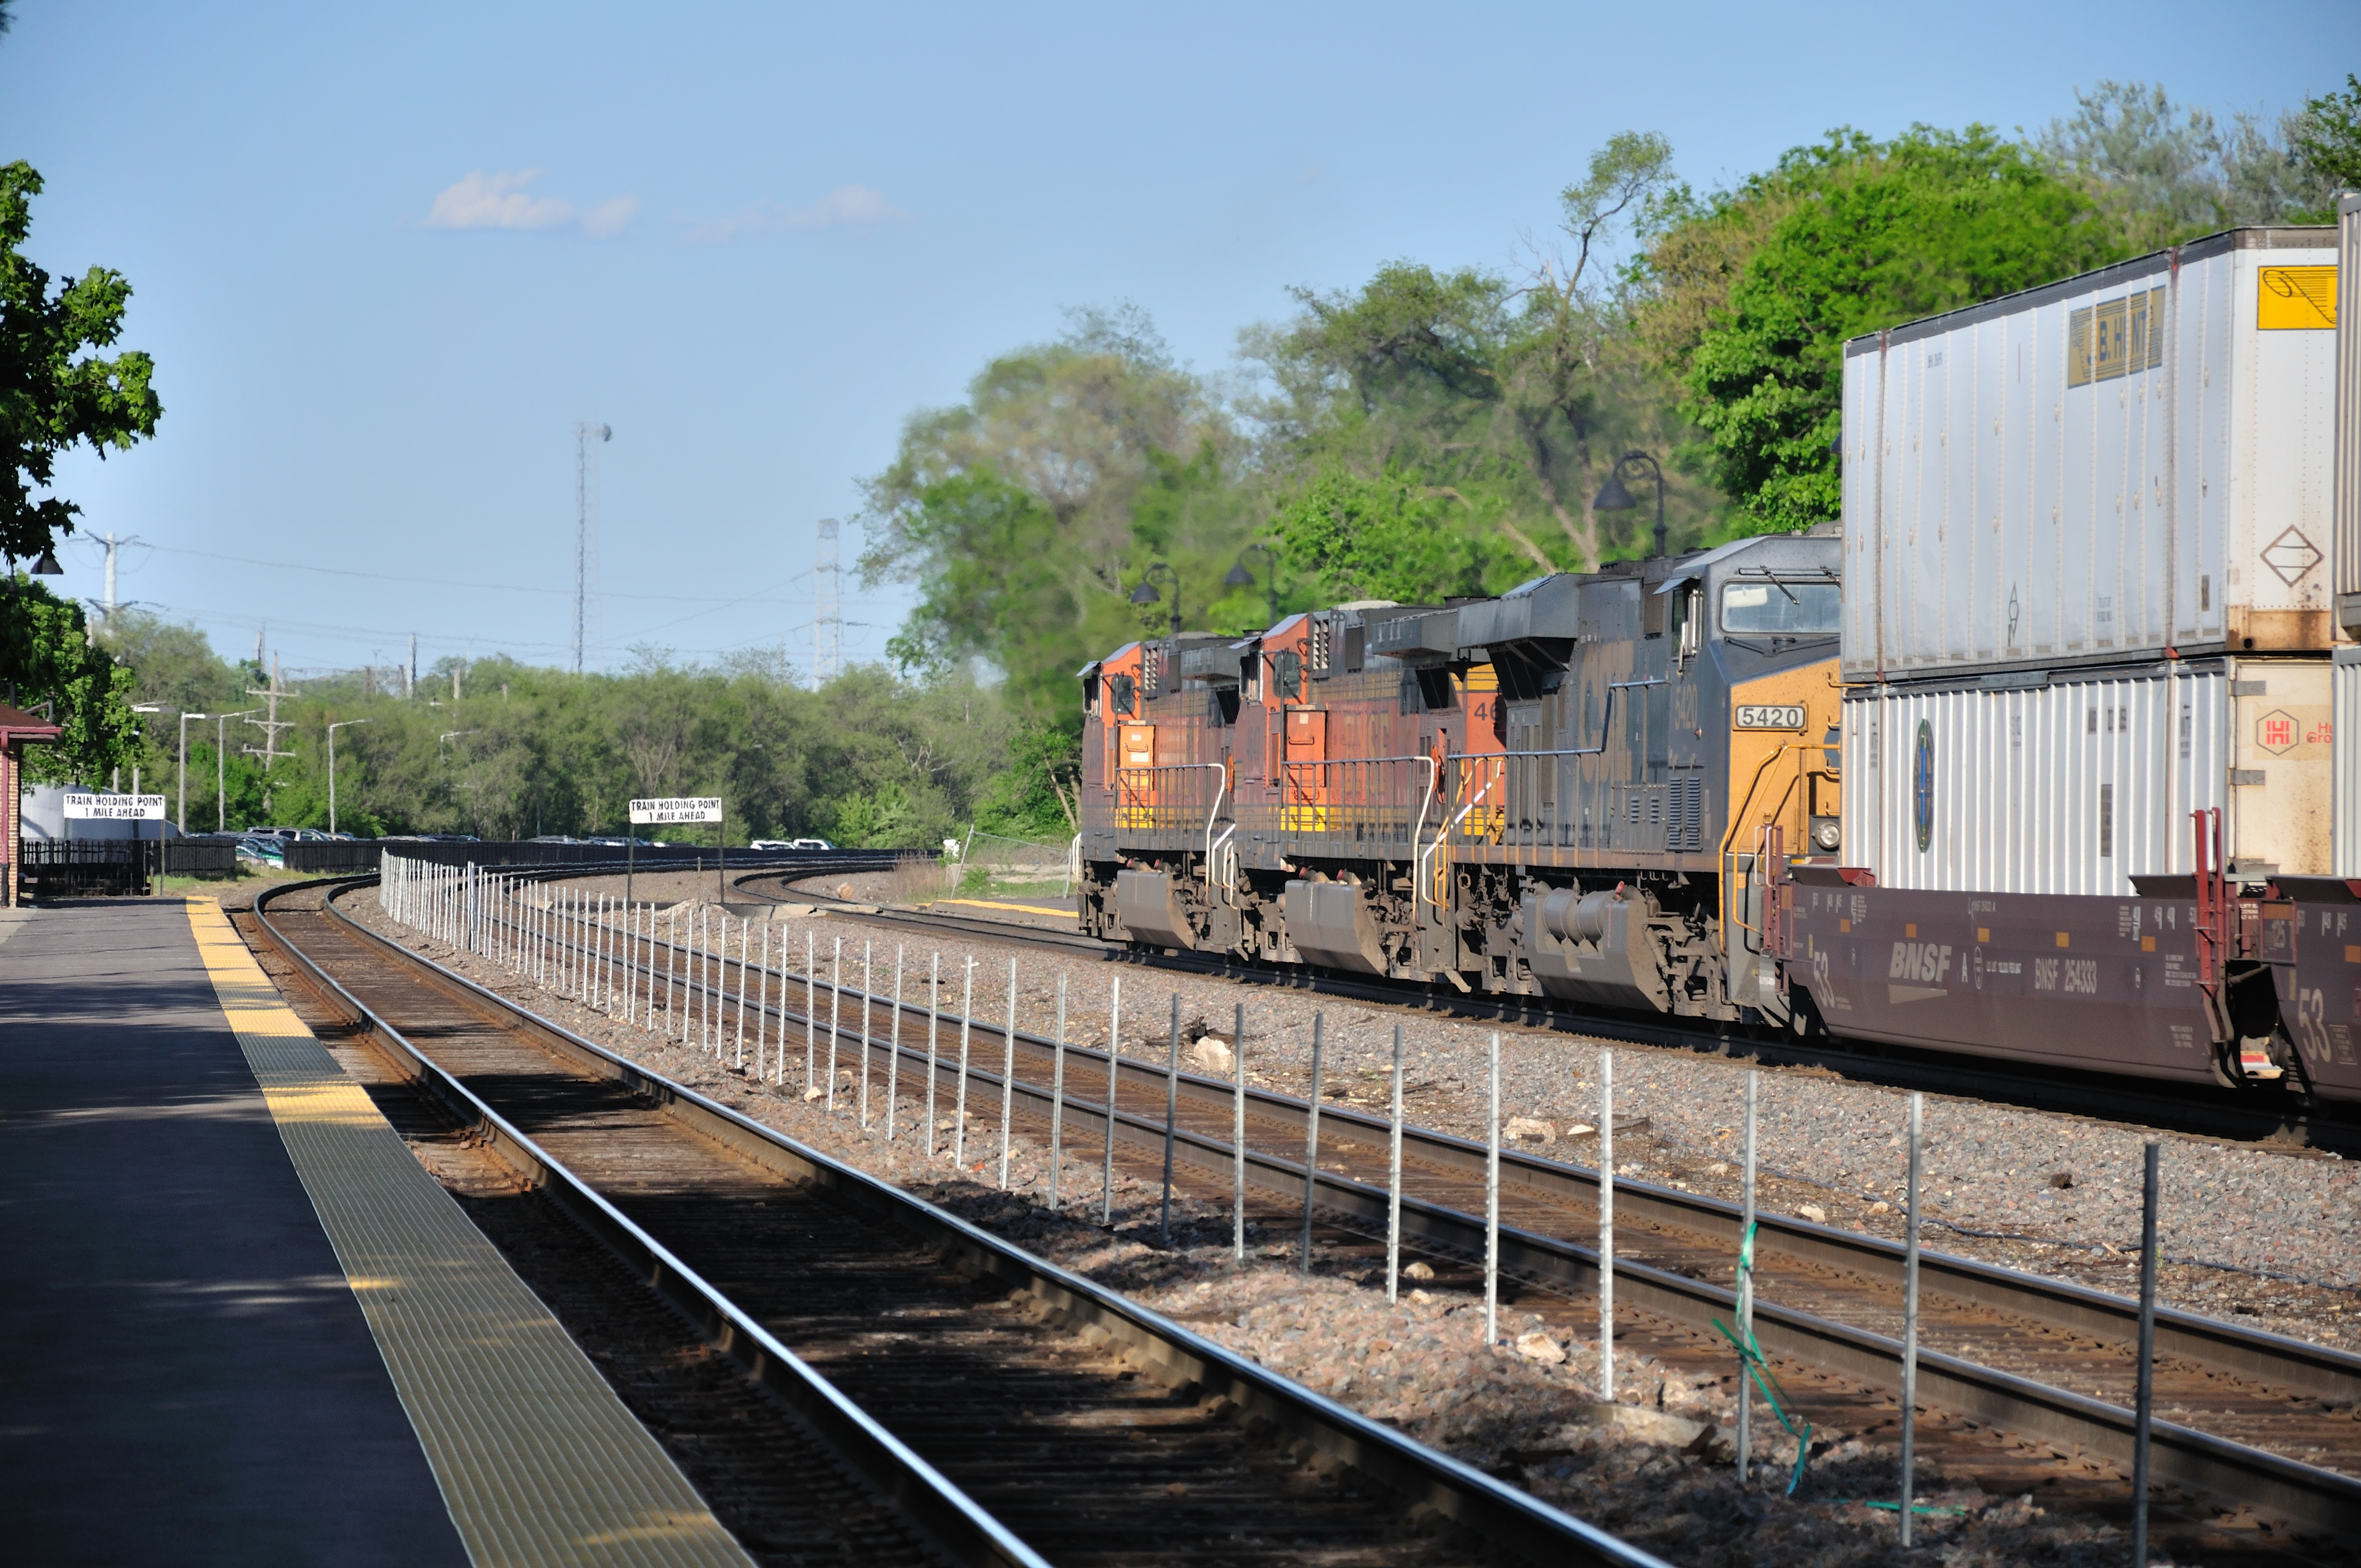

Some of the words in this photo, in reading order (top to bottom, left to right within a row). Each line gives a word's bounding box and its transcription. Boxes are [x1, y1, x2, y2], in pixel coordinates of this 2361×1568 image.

[1675, 684, 1698, 730] 5420
[1742, 708, 1798, 726] 5420
[66, 796, 92, 805] TRAIN
[95, 796, 133, 806] HOLDING
[137, 797, 162, 807] POINT
[85, 808, 89, 817] 1
[93, 808, 113, 817] MILE
[116, 808, 145, 817] AHEAD
[632, 801, 655, 811] TRAIN
[659, 800, 695, 810] HOLDING
[698, 799, 719, 809] POINT
[649, 812, 652, 821] 1
[656, 812, 675, 821] MILE
[679, 811, 705, 820] AHEAD
[1890, 942, 1952, 982] BNSF
[1962, 952, 1968, 983] A
[2035, 957, 2059, 990] BNSF
[2064, 959, 2097, 994] 254333
[1814, 951, 1835, 1008] 53
[2299, 988, 2332, 1063] 53
